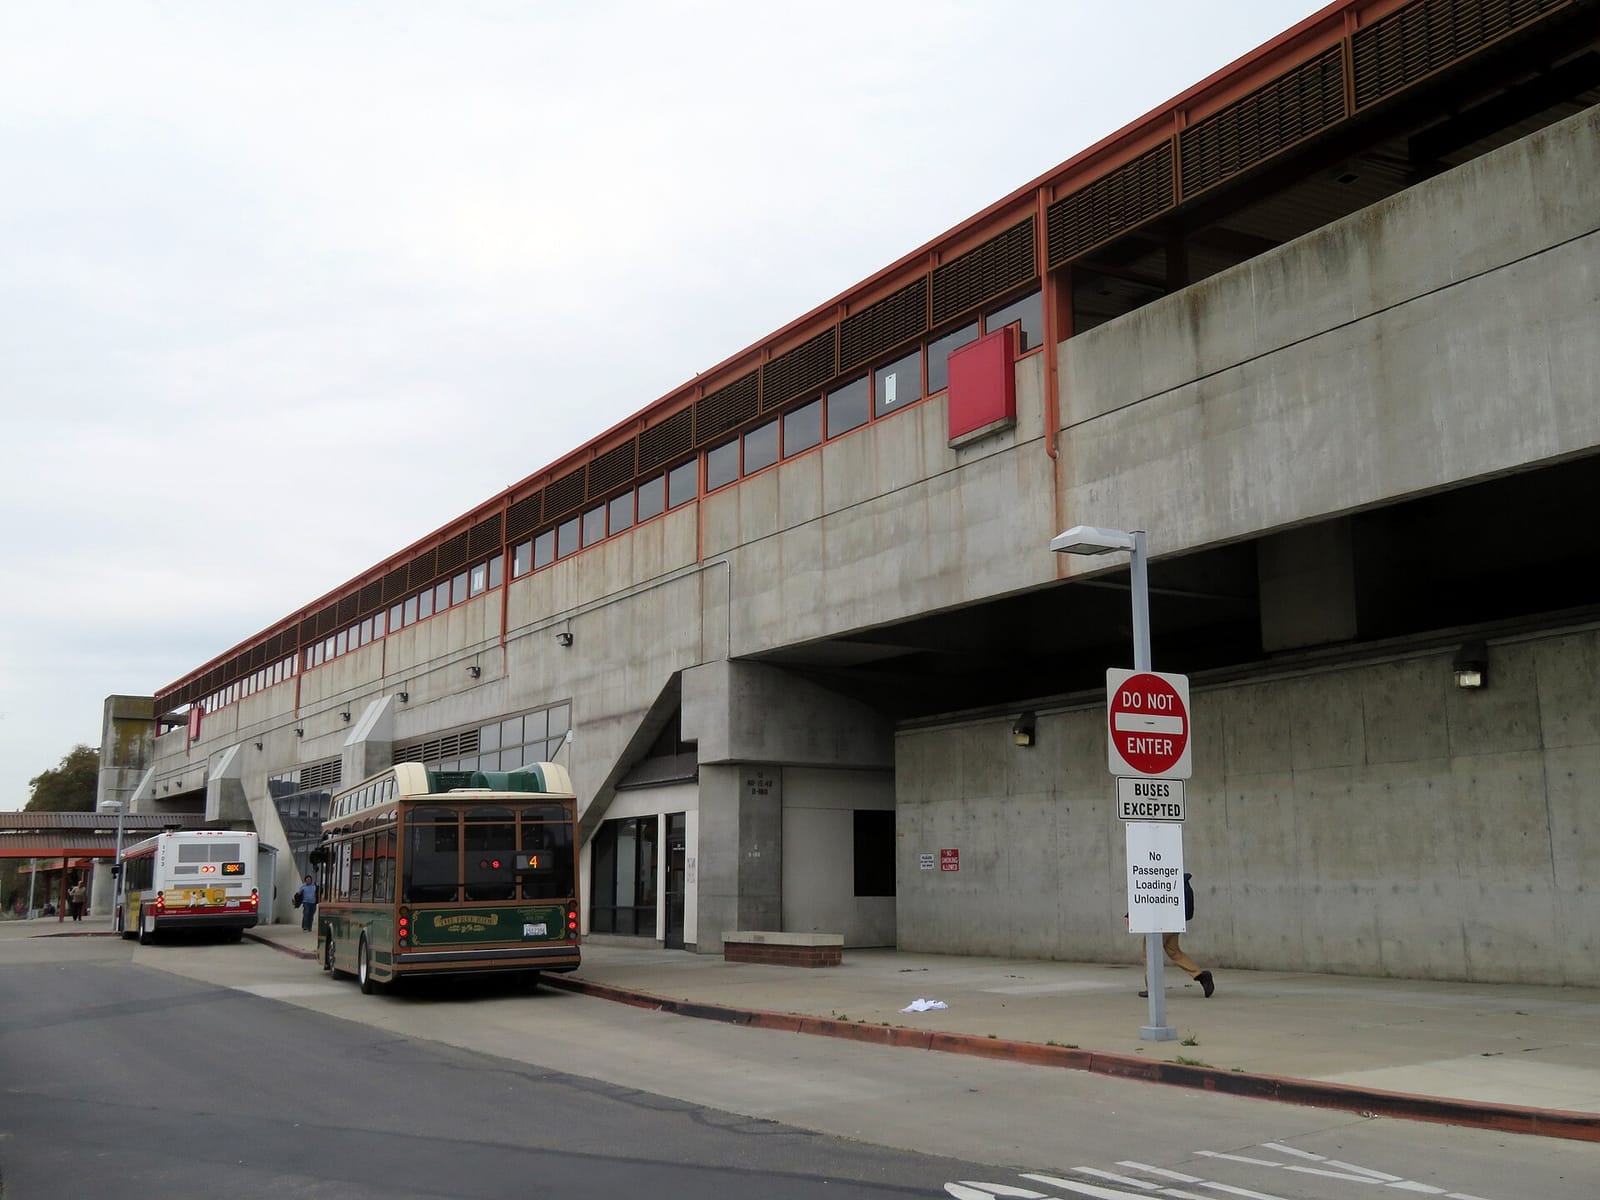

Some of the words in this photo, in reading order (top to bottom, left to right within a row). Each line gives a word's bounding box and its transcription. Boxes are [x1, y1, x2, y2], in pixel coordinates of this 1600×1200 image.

[1122, 691, 1142, 708] DO
[1147, 693, 1174, 711] NOT
[1127, 737, 1173, 756] ENTER
[1134, 783, 1170, 797] BUSES
[1123, 802, 1181, 817] EXCEPTED
[529, 855, 538, 869] 4
[1149, 851, 1162, 861] No
[1132, 865, 1179, 877] Passenger
[1135, 880, 1172, 891] Loading
[1134, 894, 1179, 906] Unloading
